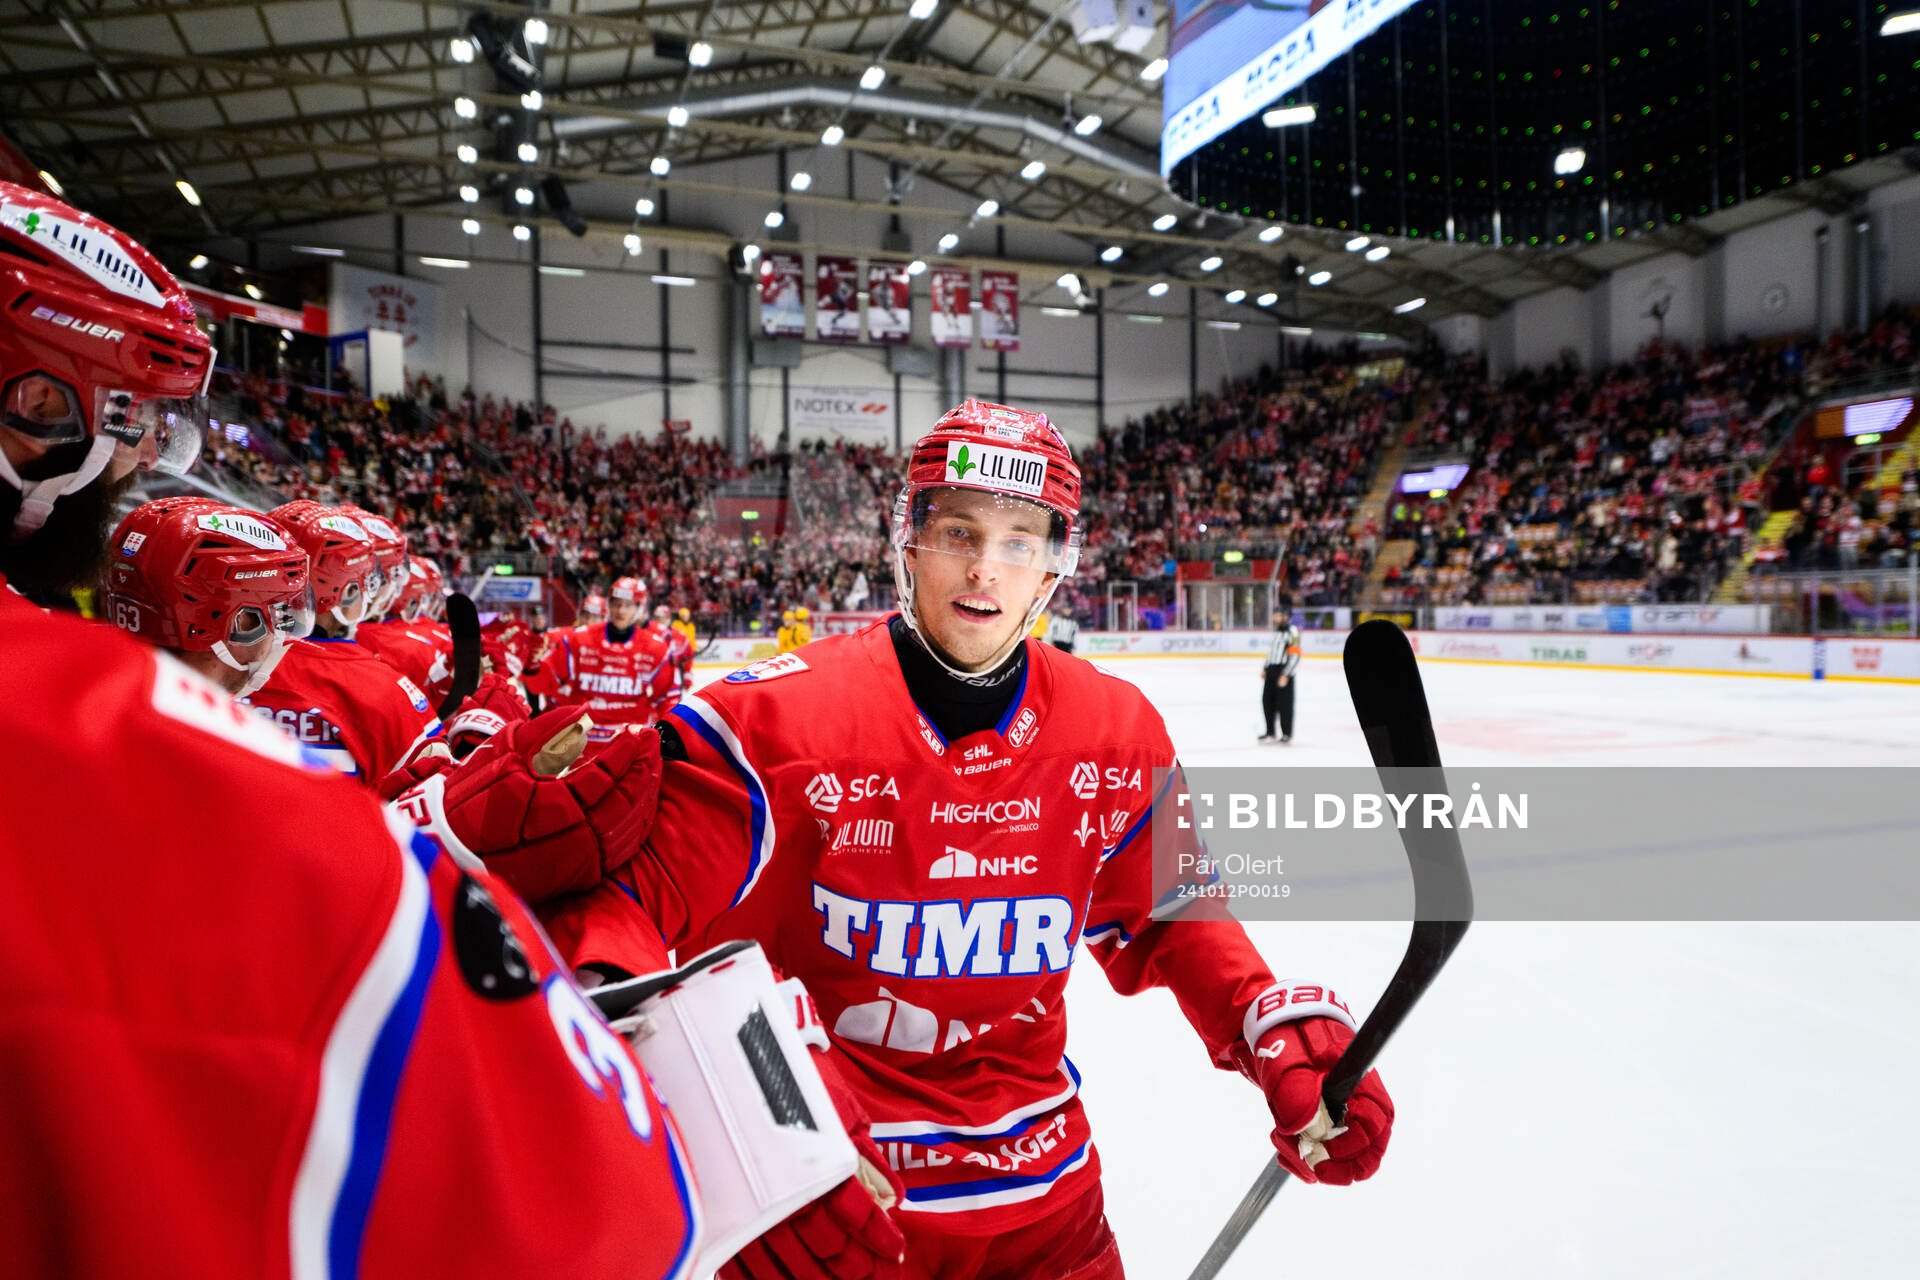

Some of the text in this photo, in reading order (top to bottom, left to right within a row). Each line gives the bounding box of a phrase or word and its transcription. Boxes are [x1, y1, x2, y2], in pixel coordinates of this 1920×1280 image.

[52, 224, 144, 289] LILIUM
[794, 398, 856, 414] NOTEX
[980, 453, 1043, 487] LILIUM
[225, 518, 275, 544] LILIUM
[116, 602, 141, 633] 63
[1009, 710, 1035, 746] EAB
[963, 743, 994, 761] SHL
[848, 774, 900, 802] SCA
[930, 796, 1040, 823] HIGHCON
[979, 855, 1038, 877] NHC
[812, 880, 1083, 979] TIMR
[872, 1113, 1067, 1172] ILBLAGET
